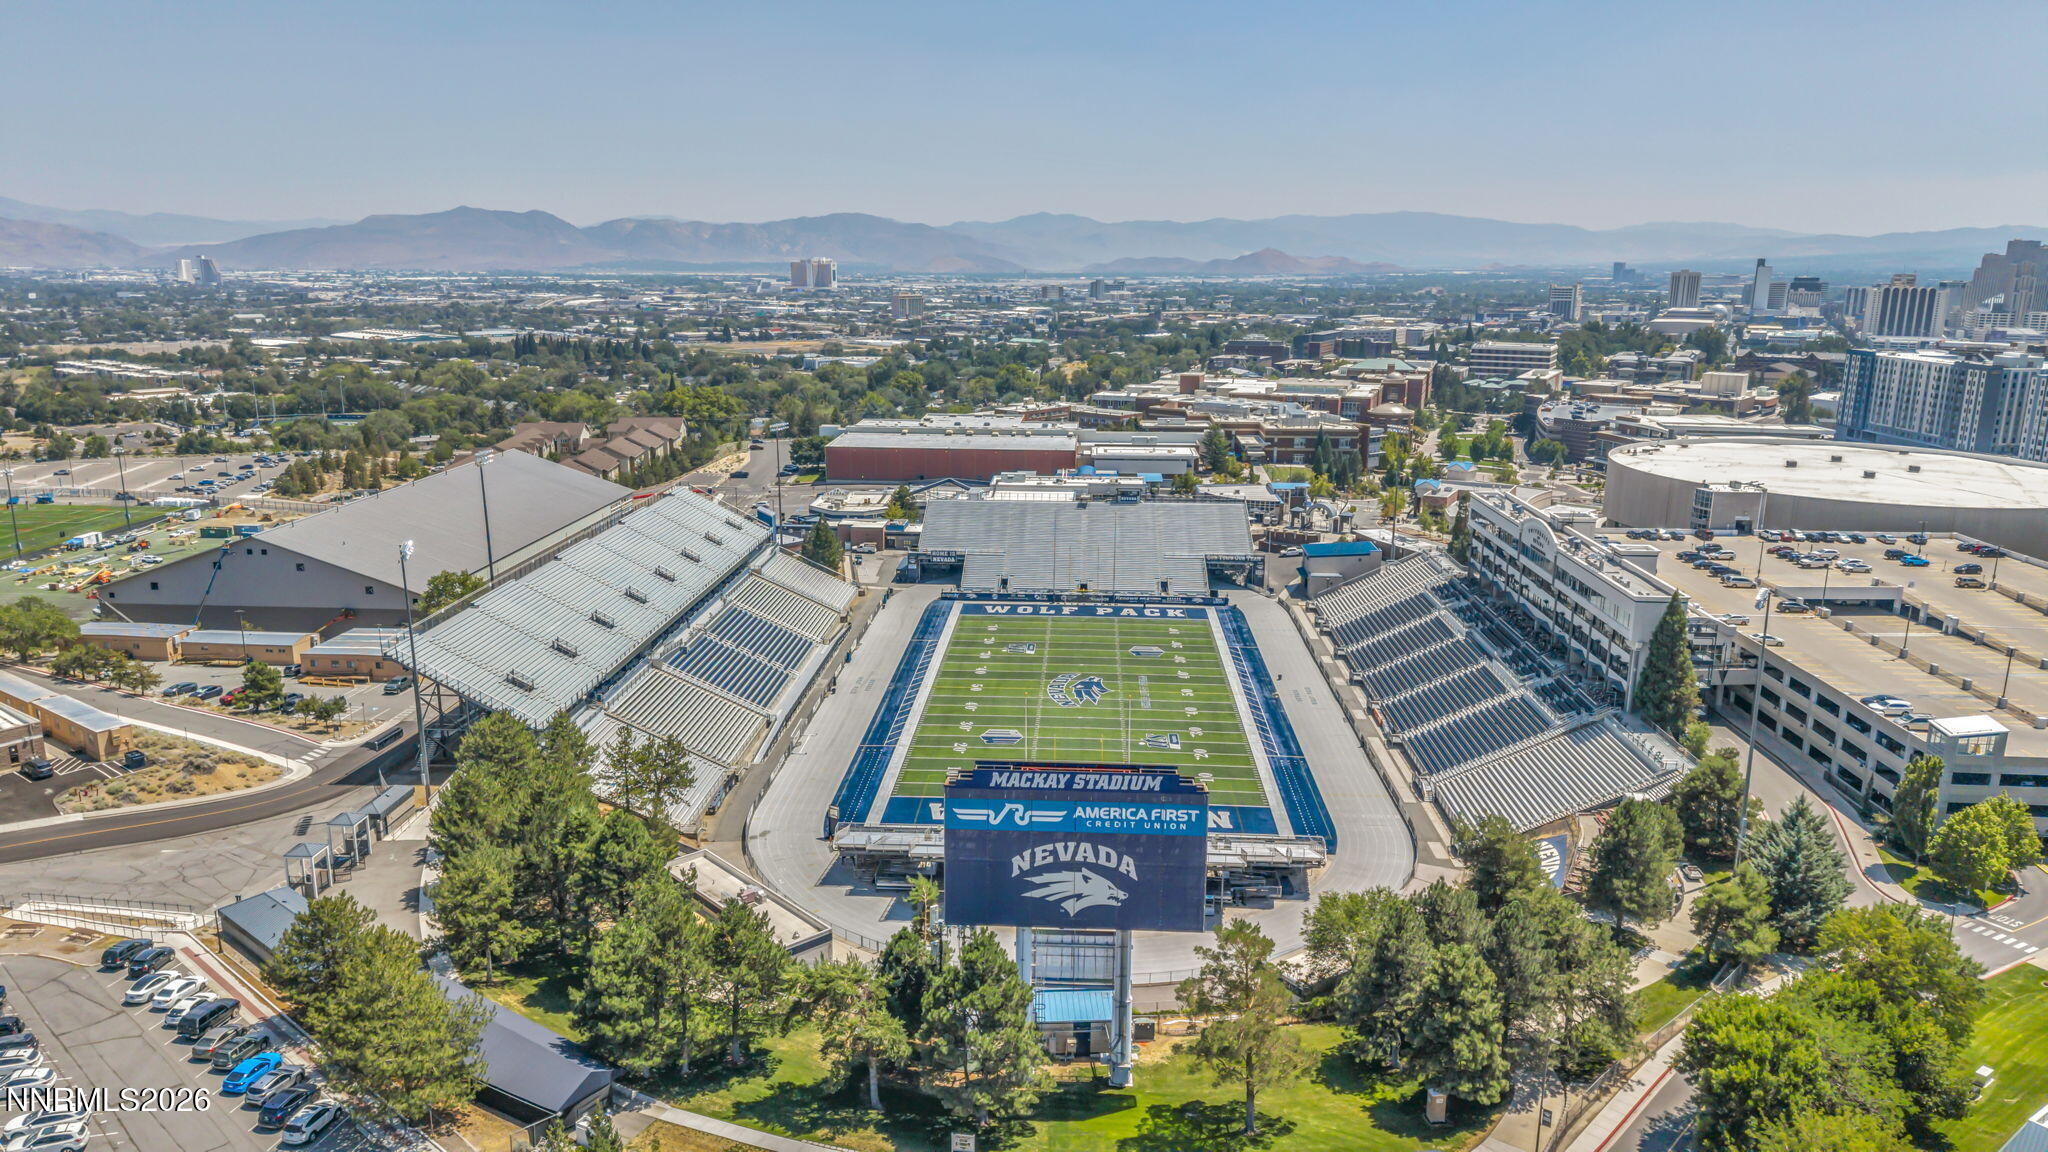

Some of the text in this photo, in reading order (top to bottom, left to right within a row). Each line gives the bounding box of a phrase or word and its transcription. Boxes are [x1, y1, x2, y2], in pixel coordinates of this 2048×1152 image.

[986, 605, 1185, 617] WOLF PACK
[990, 772, 1163, 792] MACKAY STADIUM
[1074, 806, 1148, 820] AMERICA
[1151, 808, 1200, 822] FIRST
[1086, 820, 1187, 830] CREDIT UNION
[1011, 842, 1138, 882] NEVADA
[1988, 915, 2024, 928] STOP
